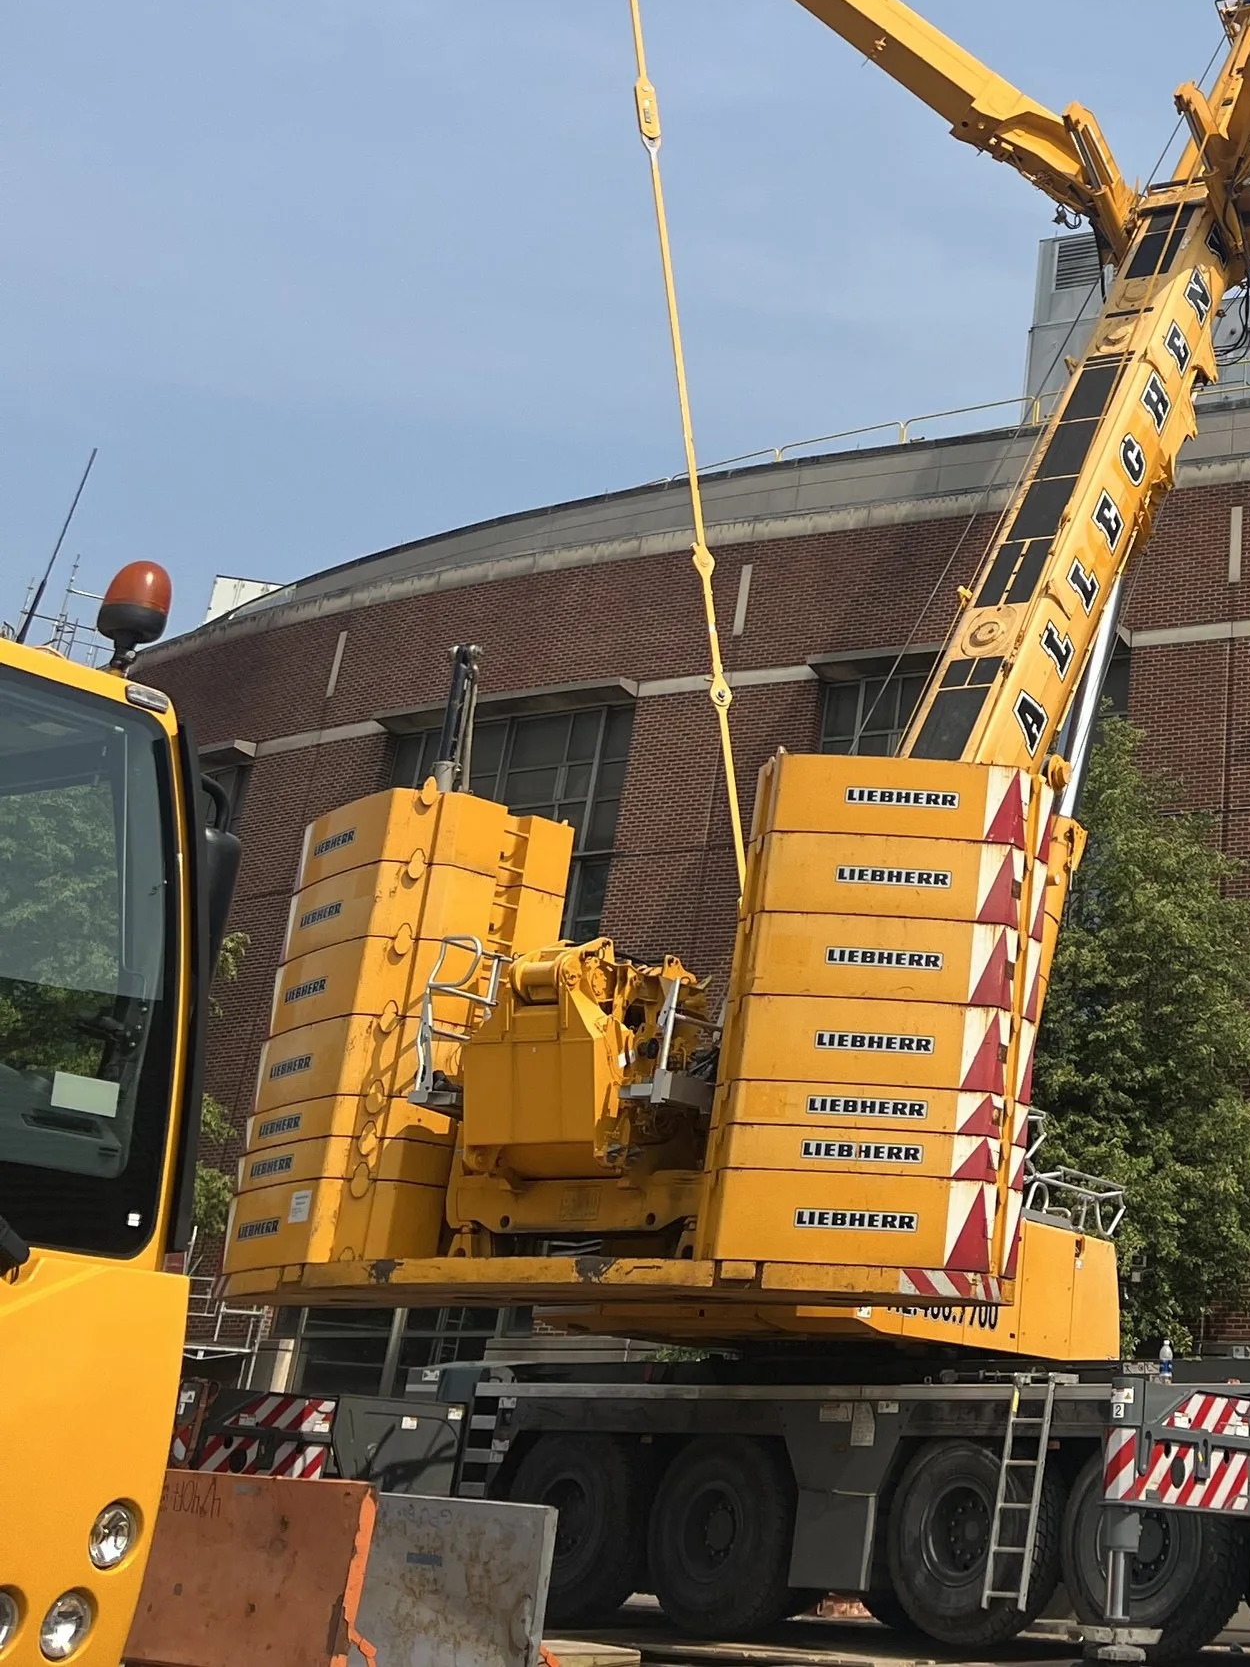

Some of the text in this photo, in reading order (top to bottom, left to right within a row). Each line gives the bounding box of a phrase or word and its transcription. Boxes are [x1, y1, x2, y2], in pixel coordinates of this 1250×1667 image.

[847, 789, 957, 807] LIEBHERR
[314, 831, 354, 856] LIEBHERR
[837, 868, 949, 886] LIEBHERR
[300, 903, 341, 926] LIEBHERR
[827, 949, 941, 968] LIEBHERR
[285, 978, 326, 1003] LIEBHERR
[816, 1033, 931, 1052] LIEBHERR
[270, 1055, 312, 1078] LIEBHERR
[808, 1098, 925, 1117] LIEBHERR
[259, 1114, 301, 1138] LIEBHERR
[802, 1142, 920, 1161] LIEBHERR
[250, 1155, 293, 1178] LIEBHERR
[238, 1218, 279, 1240] LIEBHERR
[796, 1211, 915, 1229] LIEBHERR
[1114, 1404, 1122, 1417] 2
